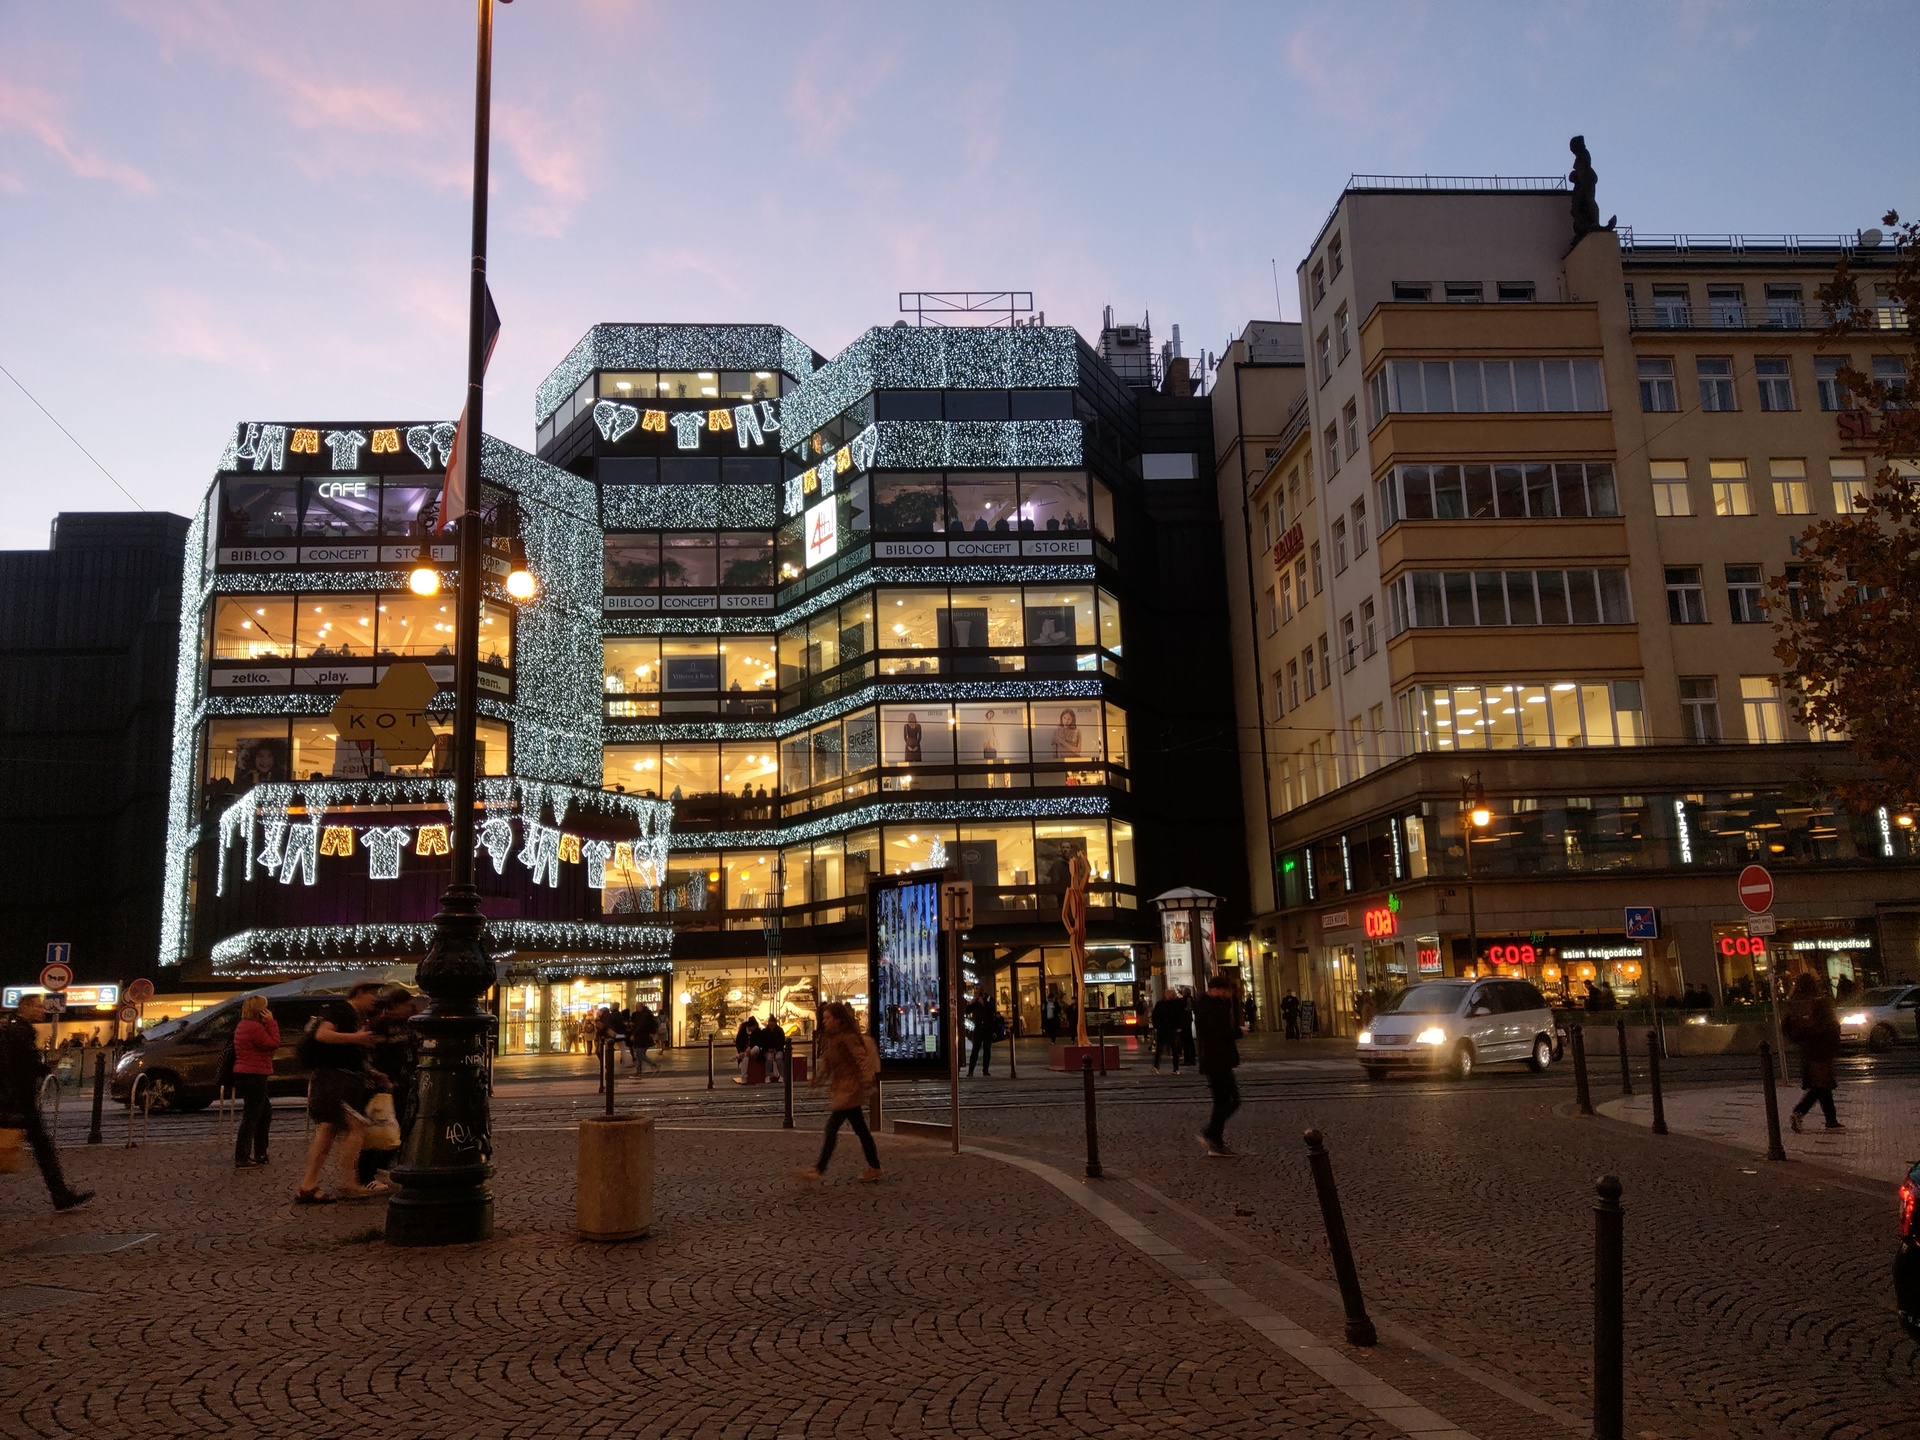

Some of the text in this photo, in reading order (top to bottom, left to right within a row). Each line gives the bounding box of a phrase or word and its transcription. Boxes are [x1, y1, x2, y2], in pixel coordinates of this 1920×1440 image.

[318, 482, 367, 498] CAFE
[230, 547, 443, 562] BIBLOO CONCEPT STOE!
[886, 541, 1080, 555] BIBLOO CONCEPT STORE!
[608, 596, 768, 608] BIBLOO CONCEPT STORE!
[232, 672, 271, 684] zetko.
[318, 669, 349, 685] play.
[350, 712, 450, 730] KOTV
[1675, 801, 1692, 863] PIZZA
[1878, 806, 1894, 856] ASTA
[1391, 818, 1401, 878] PIZZA
[1365, 909, 1393, 937] coa
[1562, 947, 1642, 960] asian feelgoodfood
[1721, 937, 1765, 956] coa
[1793, 940, 1871, 951] asian feelgoodfood
[1420, 949, 1440, 967] coa
[1490, 945, 1535, 964] coa
